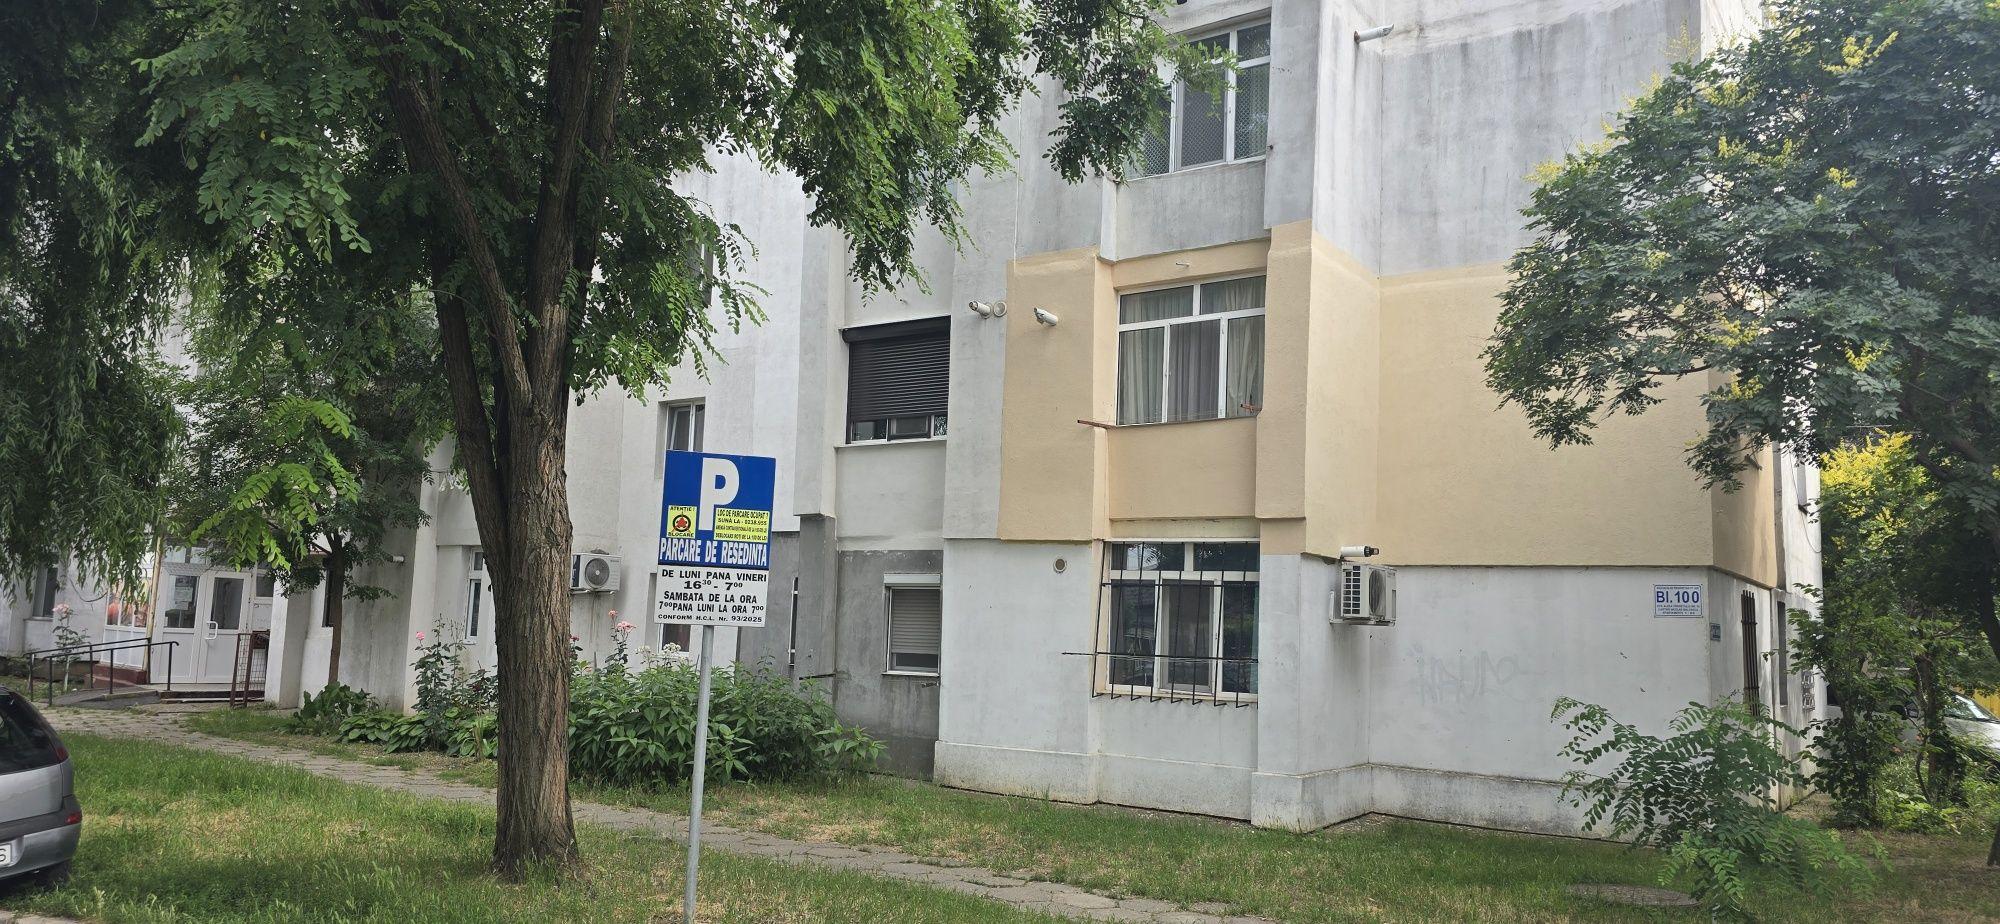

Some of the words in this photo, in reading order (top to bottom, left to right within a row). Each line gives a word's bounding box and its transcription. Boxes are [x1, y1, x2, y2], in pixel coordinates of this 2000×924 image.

[699, 457, 740, 530] P
[717, 509, 725, 517] LOC
[725, 509, 732, 517] DE
[732, 510, 750, 519] PARCARE
[750, 511, 766, 519] OCUPAT
[660, 537, 701, 561] PARCARE
[705, 540, 718, 563] DE
[721, 541, 767, 566] RESEDINTA
[662, 569, 674, 578] DE
[679, 570, 701, 579] LUNI
[706, 571, 731, 580] PANA
[736, 572, 767, 582] VINERI
[664, 590, 704, 602] SAMBATA
[708, 593, 720, 602] DE
[724, 594, 735, 603] LA
[740, 595, 757, 604] ORA
[697, 603, 714, 612] LUNI
[718, 604, 728, 612] LA
[732, 605, 747, 613] ORA
[731, 615, 762, 623] 93/2025
